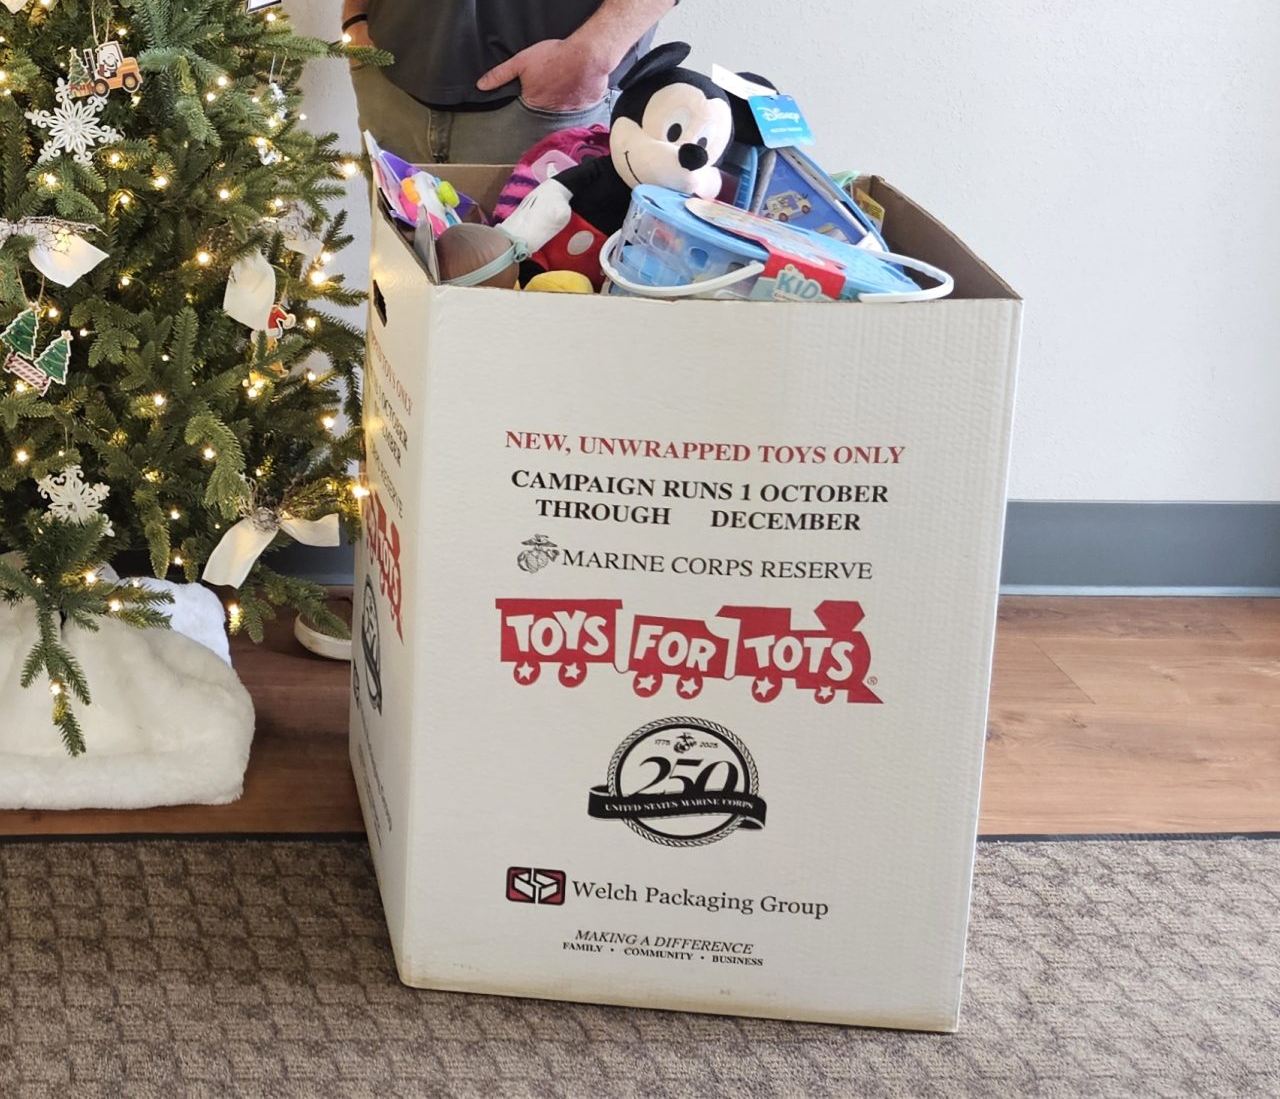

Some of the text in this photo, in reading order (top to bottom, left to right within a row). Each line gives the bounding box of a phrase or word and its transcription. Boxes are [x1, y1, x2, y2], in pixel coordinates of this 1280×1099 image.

[756, 107, 800, 123] Disney
[505, 431, 906, 465] NEW, UNWRAPPED TOYS ONLY
[511, 470, 888, 504] CAMPAIGN RUNS 1 OCTOBER
[535, 499, 861, 531] THROUGH DECEMBER
[562, 548, 873, 581] MARINE CORPS RESERVE
[506, 610, 855, 682] TOYS FOR TOTS
[629, 756, 738, 797] 250
[605, 798, 754, 812] UNITED STATES MARINE CORPS
[572, 880, 829, 920] Welch Packaging Group
[562, 941, 764, 966] FAMILY COMMUNITY BUSINESS
[575, 929, 753, 955] MAKING A DIFFERENCE
